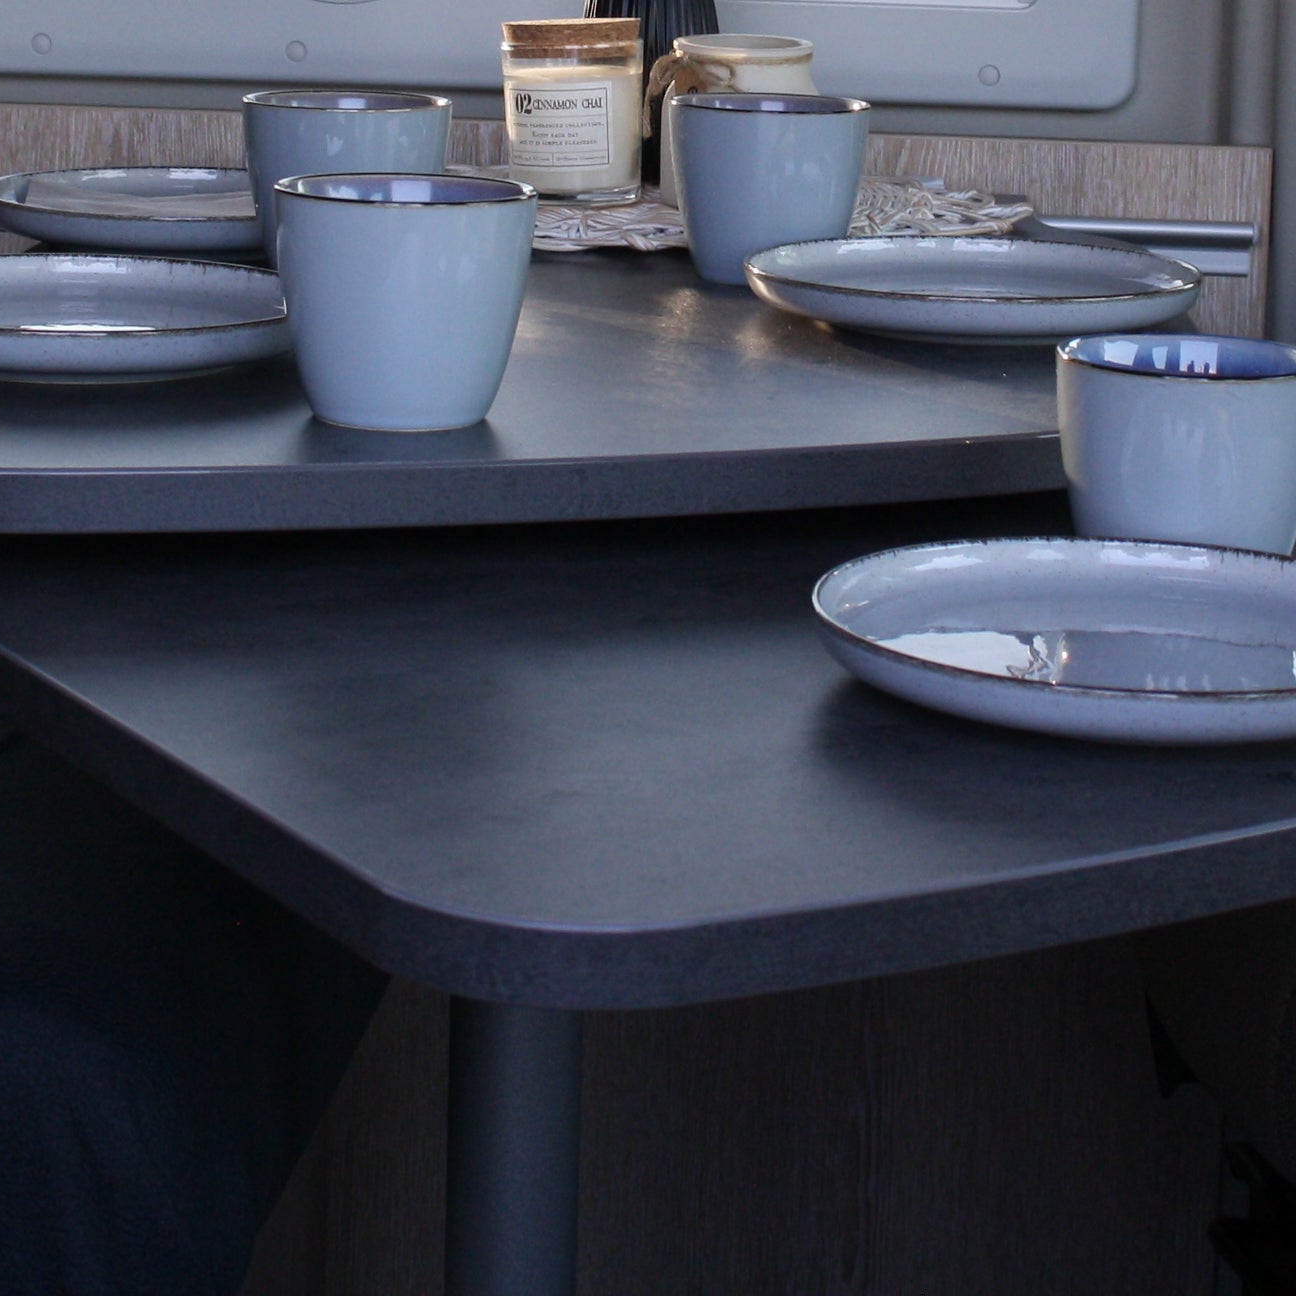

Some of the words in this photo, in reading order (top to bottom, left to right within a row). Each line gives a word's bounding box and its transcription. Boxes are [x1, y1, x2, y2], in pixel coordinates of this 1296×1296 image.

[515, 93, 532, 114] 02
[532, 98, 578, 110] CINNAMON
[581, 97, 602, 109] CHAI
